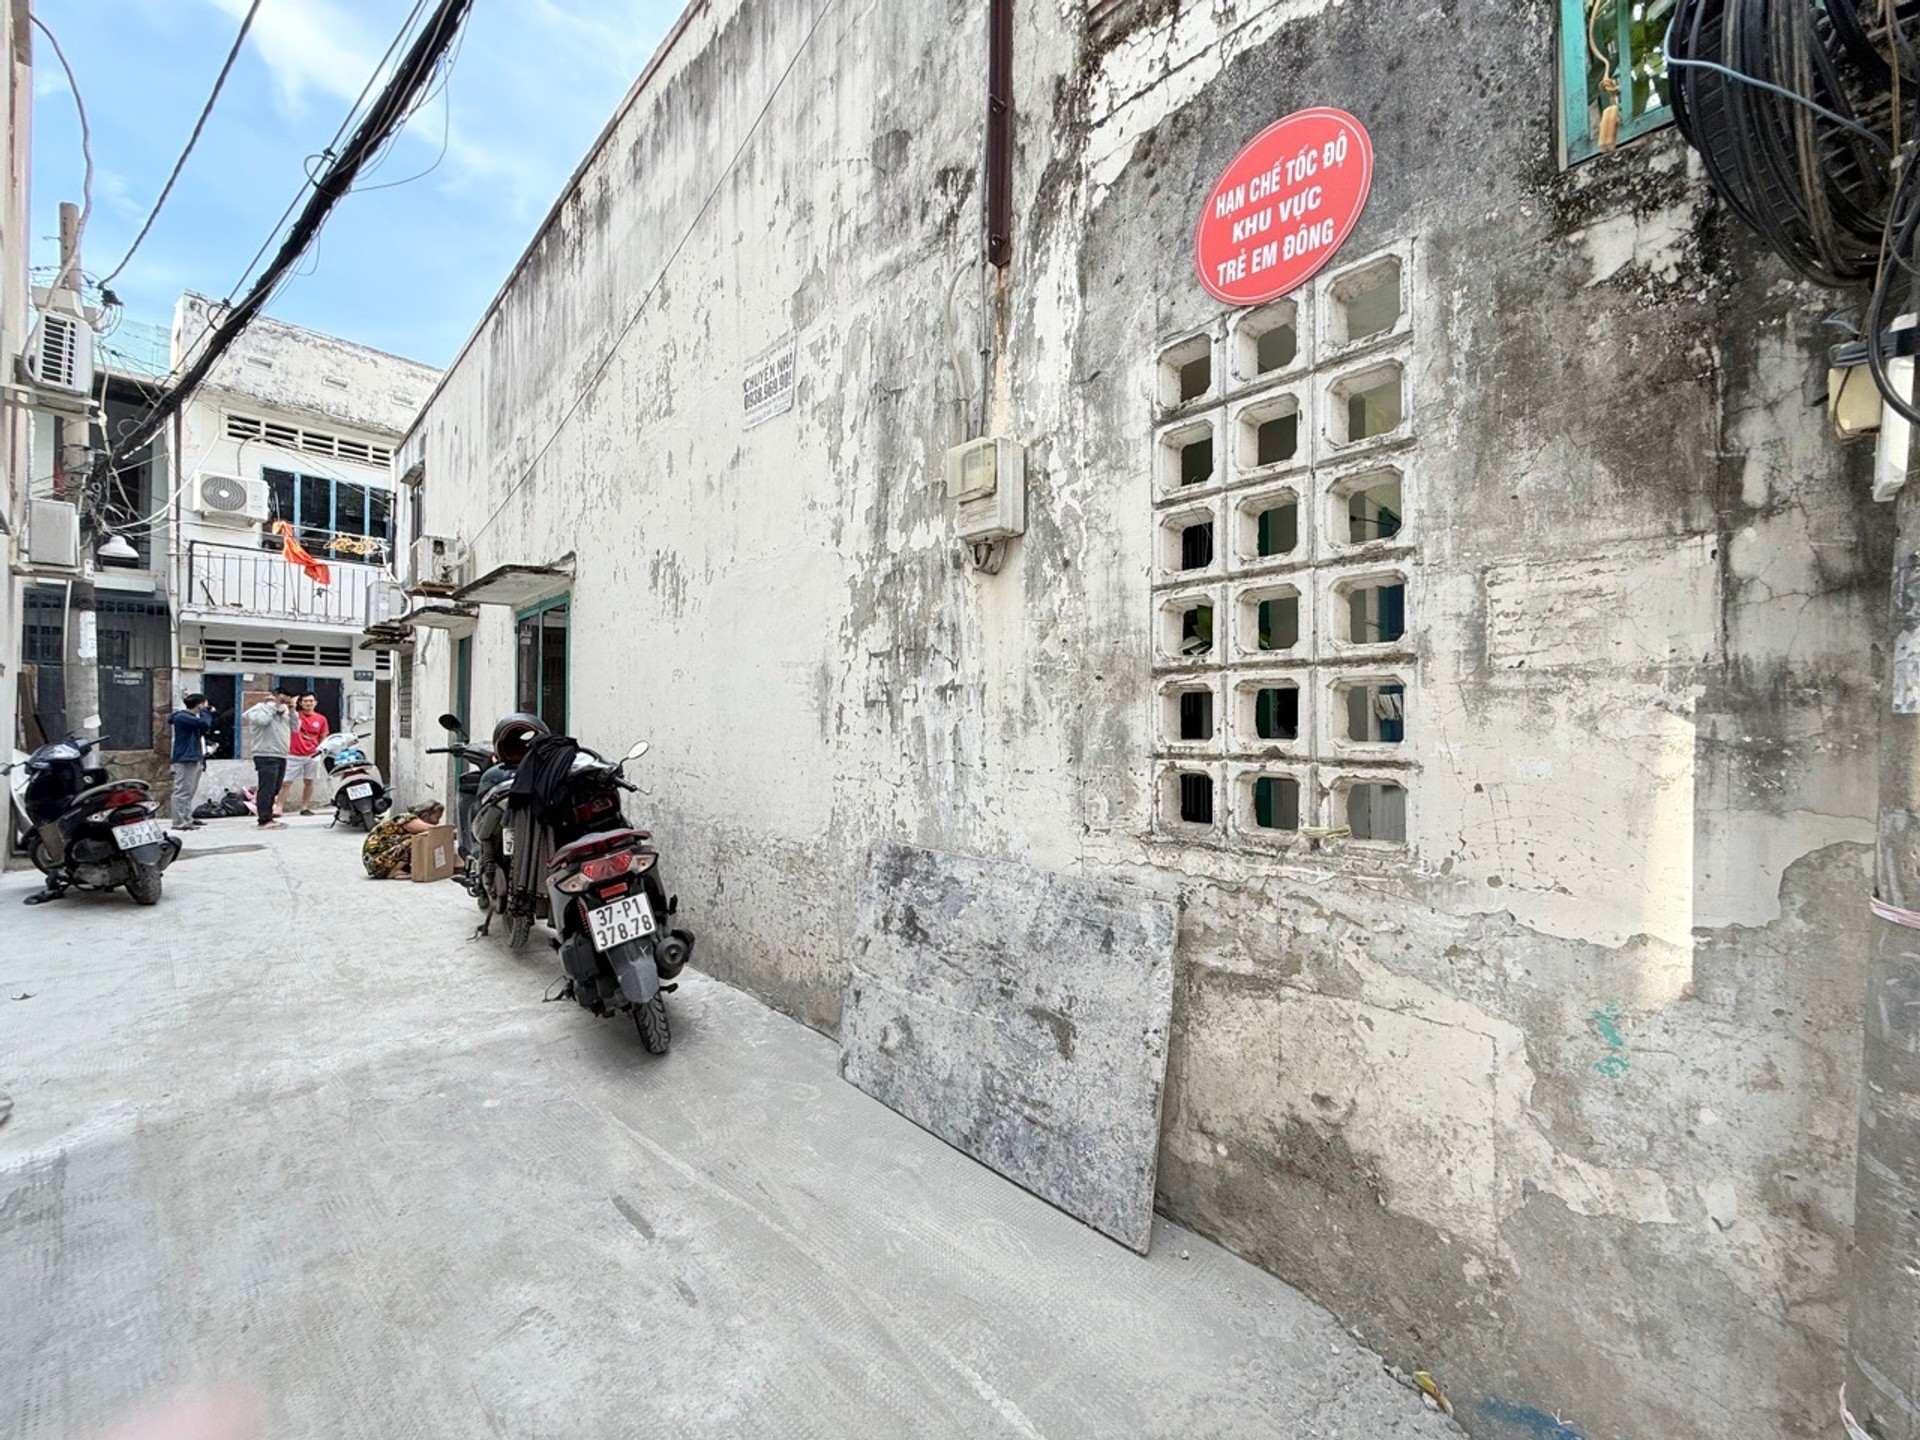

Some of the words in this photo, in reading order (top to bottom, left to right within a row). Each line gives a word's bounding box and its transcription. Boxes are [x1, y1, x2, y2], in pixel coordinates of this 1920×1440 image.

[1215, 183, 1245, 219] HẠN
[1250, 156, 1284, 203] CHẾ
[1286, 144, 1318, 186] TỐC
[1323, 129, 1348, 169] ĐỘ
[1232, 207, 1272, 244] KHU
[1279, 186, 1322, 223] VỰC
[1216, 248, 1247, 287] TRẺ
[1251, 240, 1278, 275] EM
[1283, 218, 1335, 261] ĐÔNG
[596, 898, 642, 927] 37-P1
[597, 914, 652, 947] 378.78
